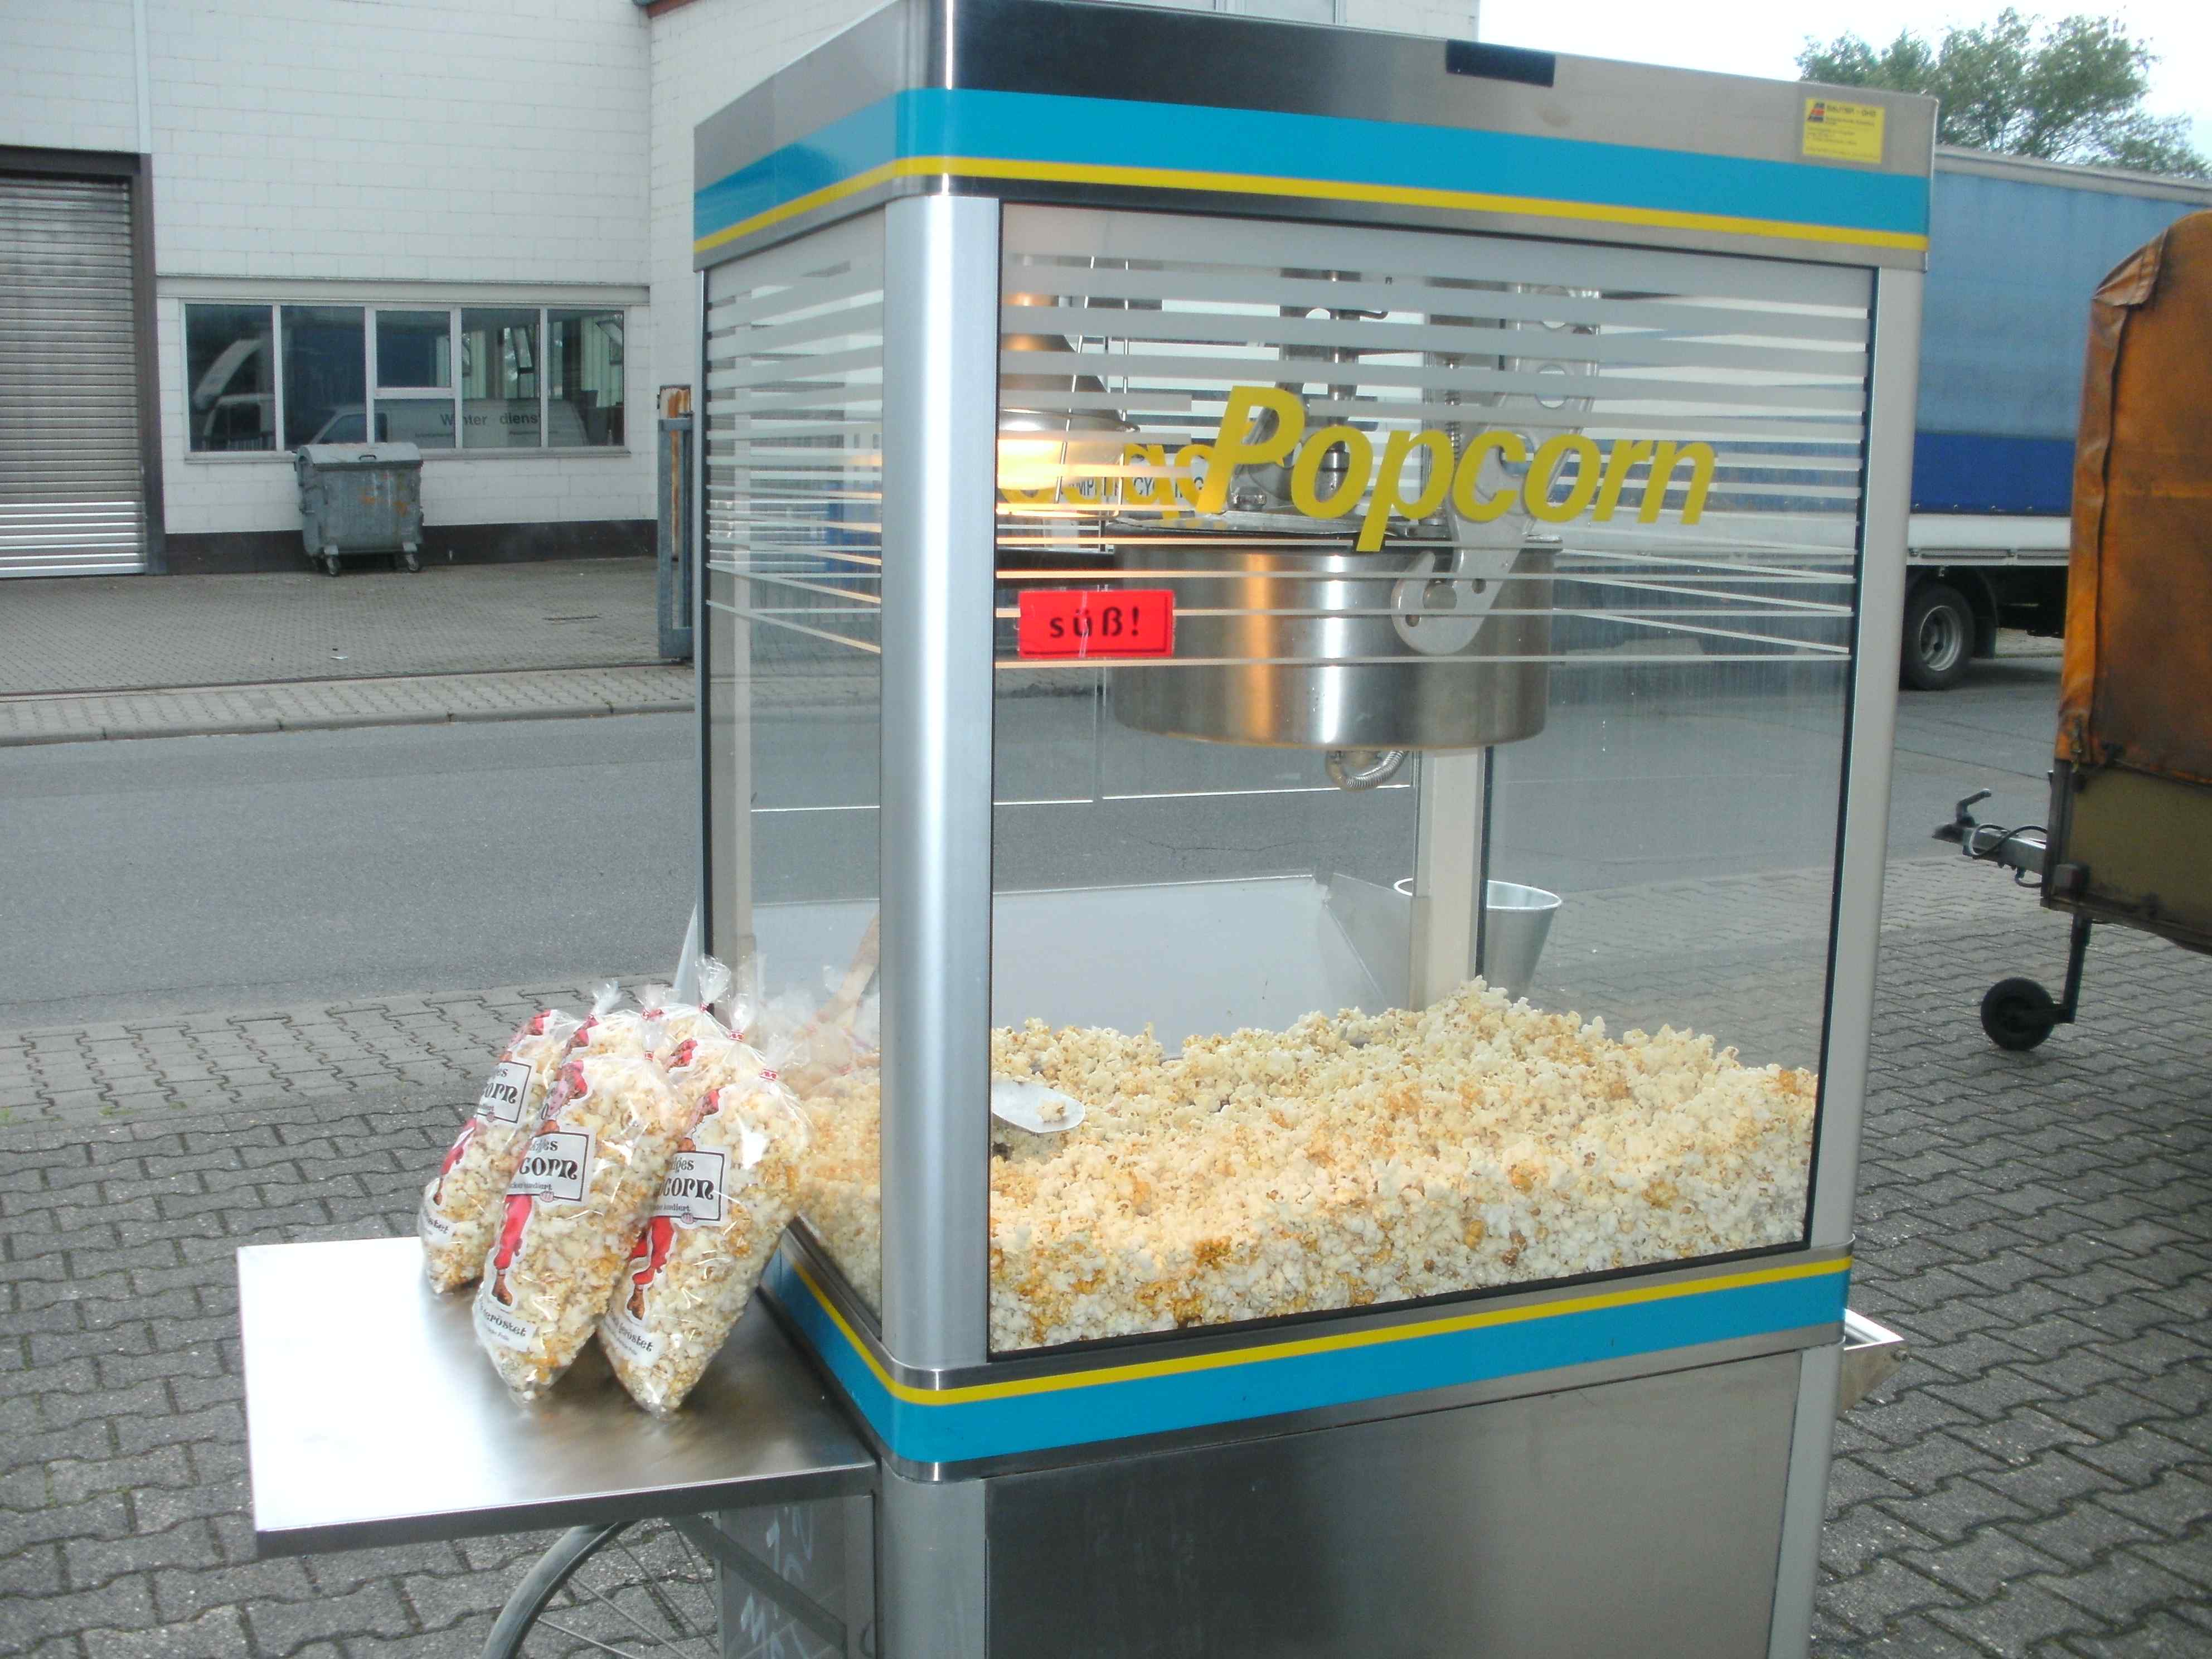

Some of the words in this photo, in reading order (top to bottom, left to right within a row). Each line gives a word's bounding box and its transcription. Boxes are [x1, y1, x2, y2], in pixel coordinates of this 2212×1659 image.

[440, 413, 488, 426] Wnter
[1196, 385, 1715, 552] Popcorn
[1049, 606, 1139, 638] süß!
[483, 1082, 518, 1104] orn
